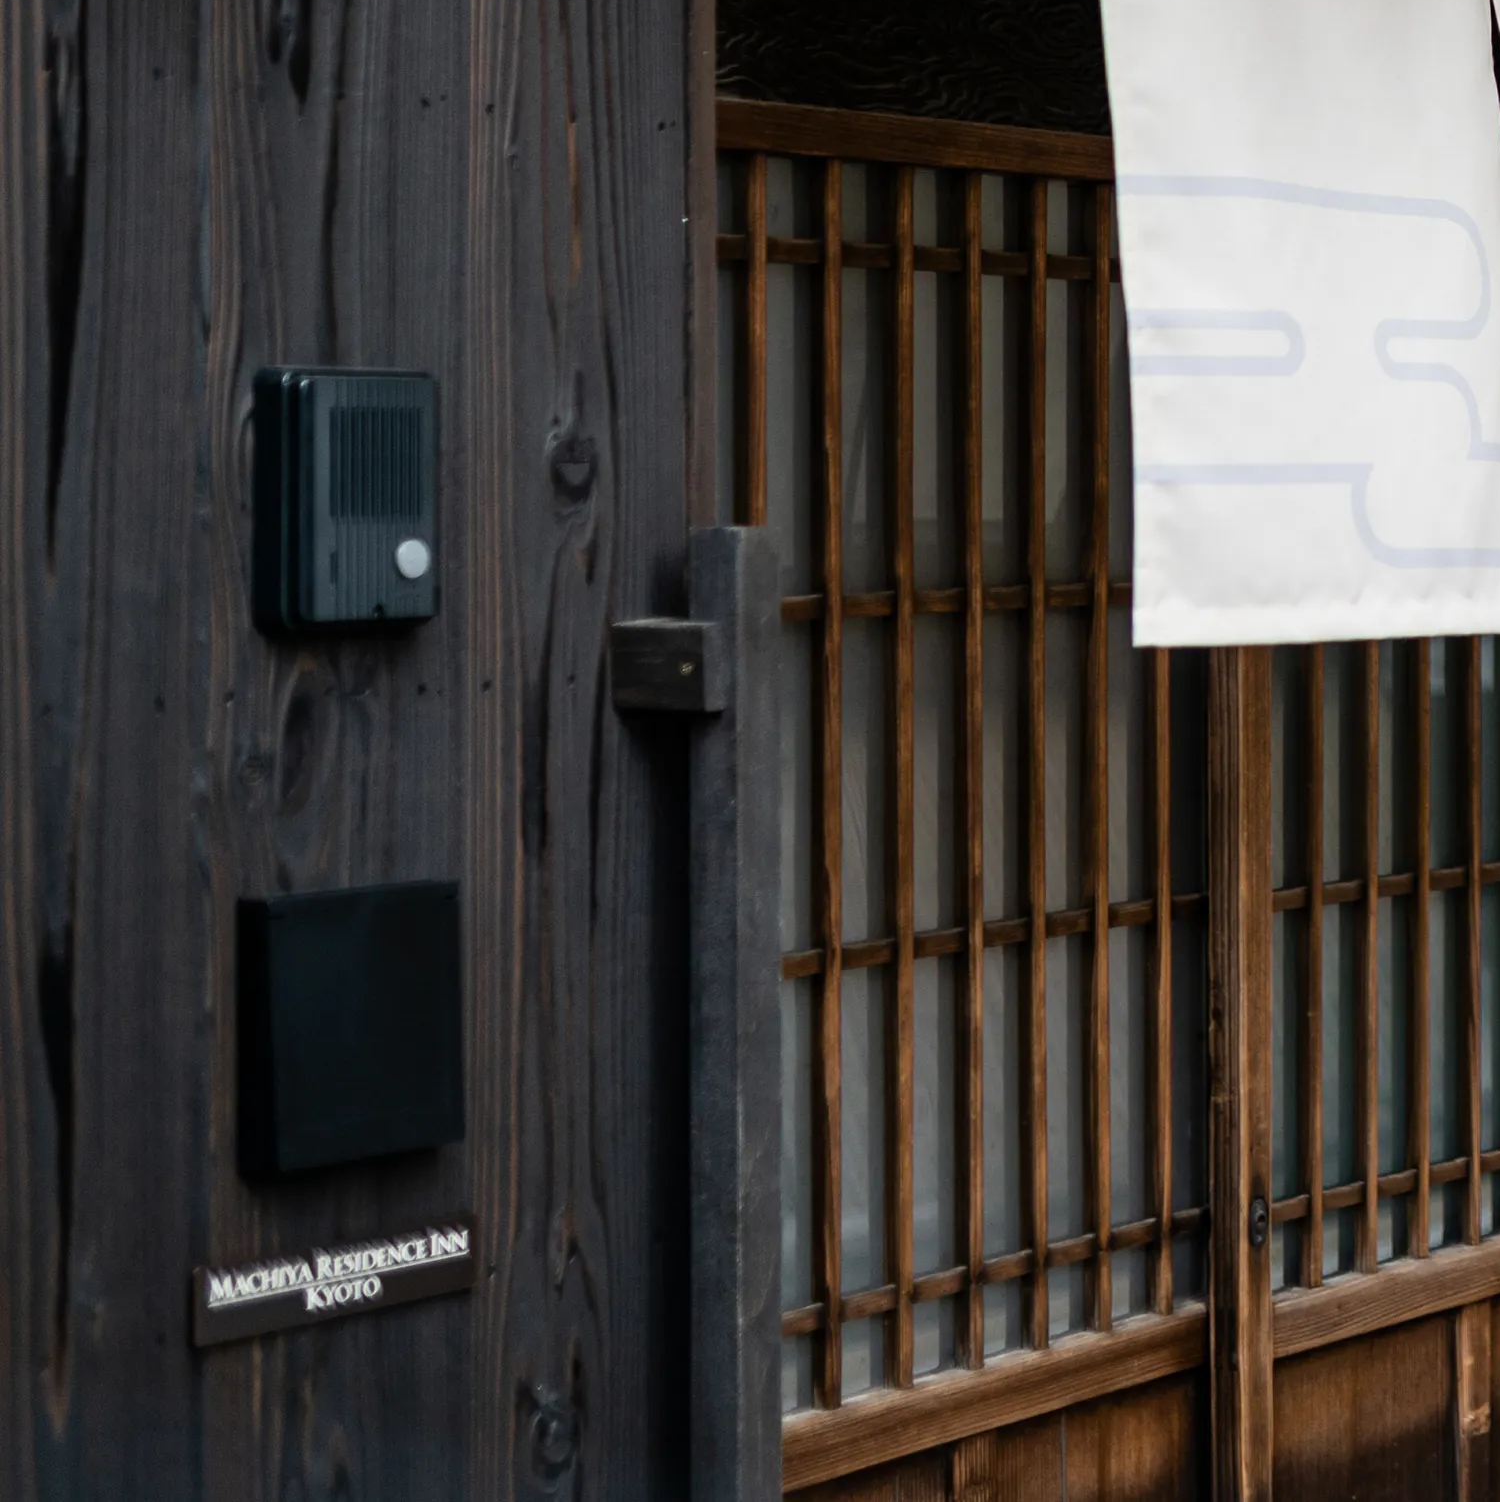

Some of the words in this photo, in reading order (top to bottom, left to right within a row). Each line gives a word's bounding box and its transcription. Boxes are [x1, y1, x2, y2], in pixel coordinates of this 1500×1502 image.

[208, 1261, 314, 1302] MACHIYA
[315, 1238, 428, 1279] RESIDENCE
[429, 1229, 469, 1257] INN
[305, 1275, 380, 1311] KYOTO
